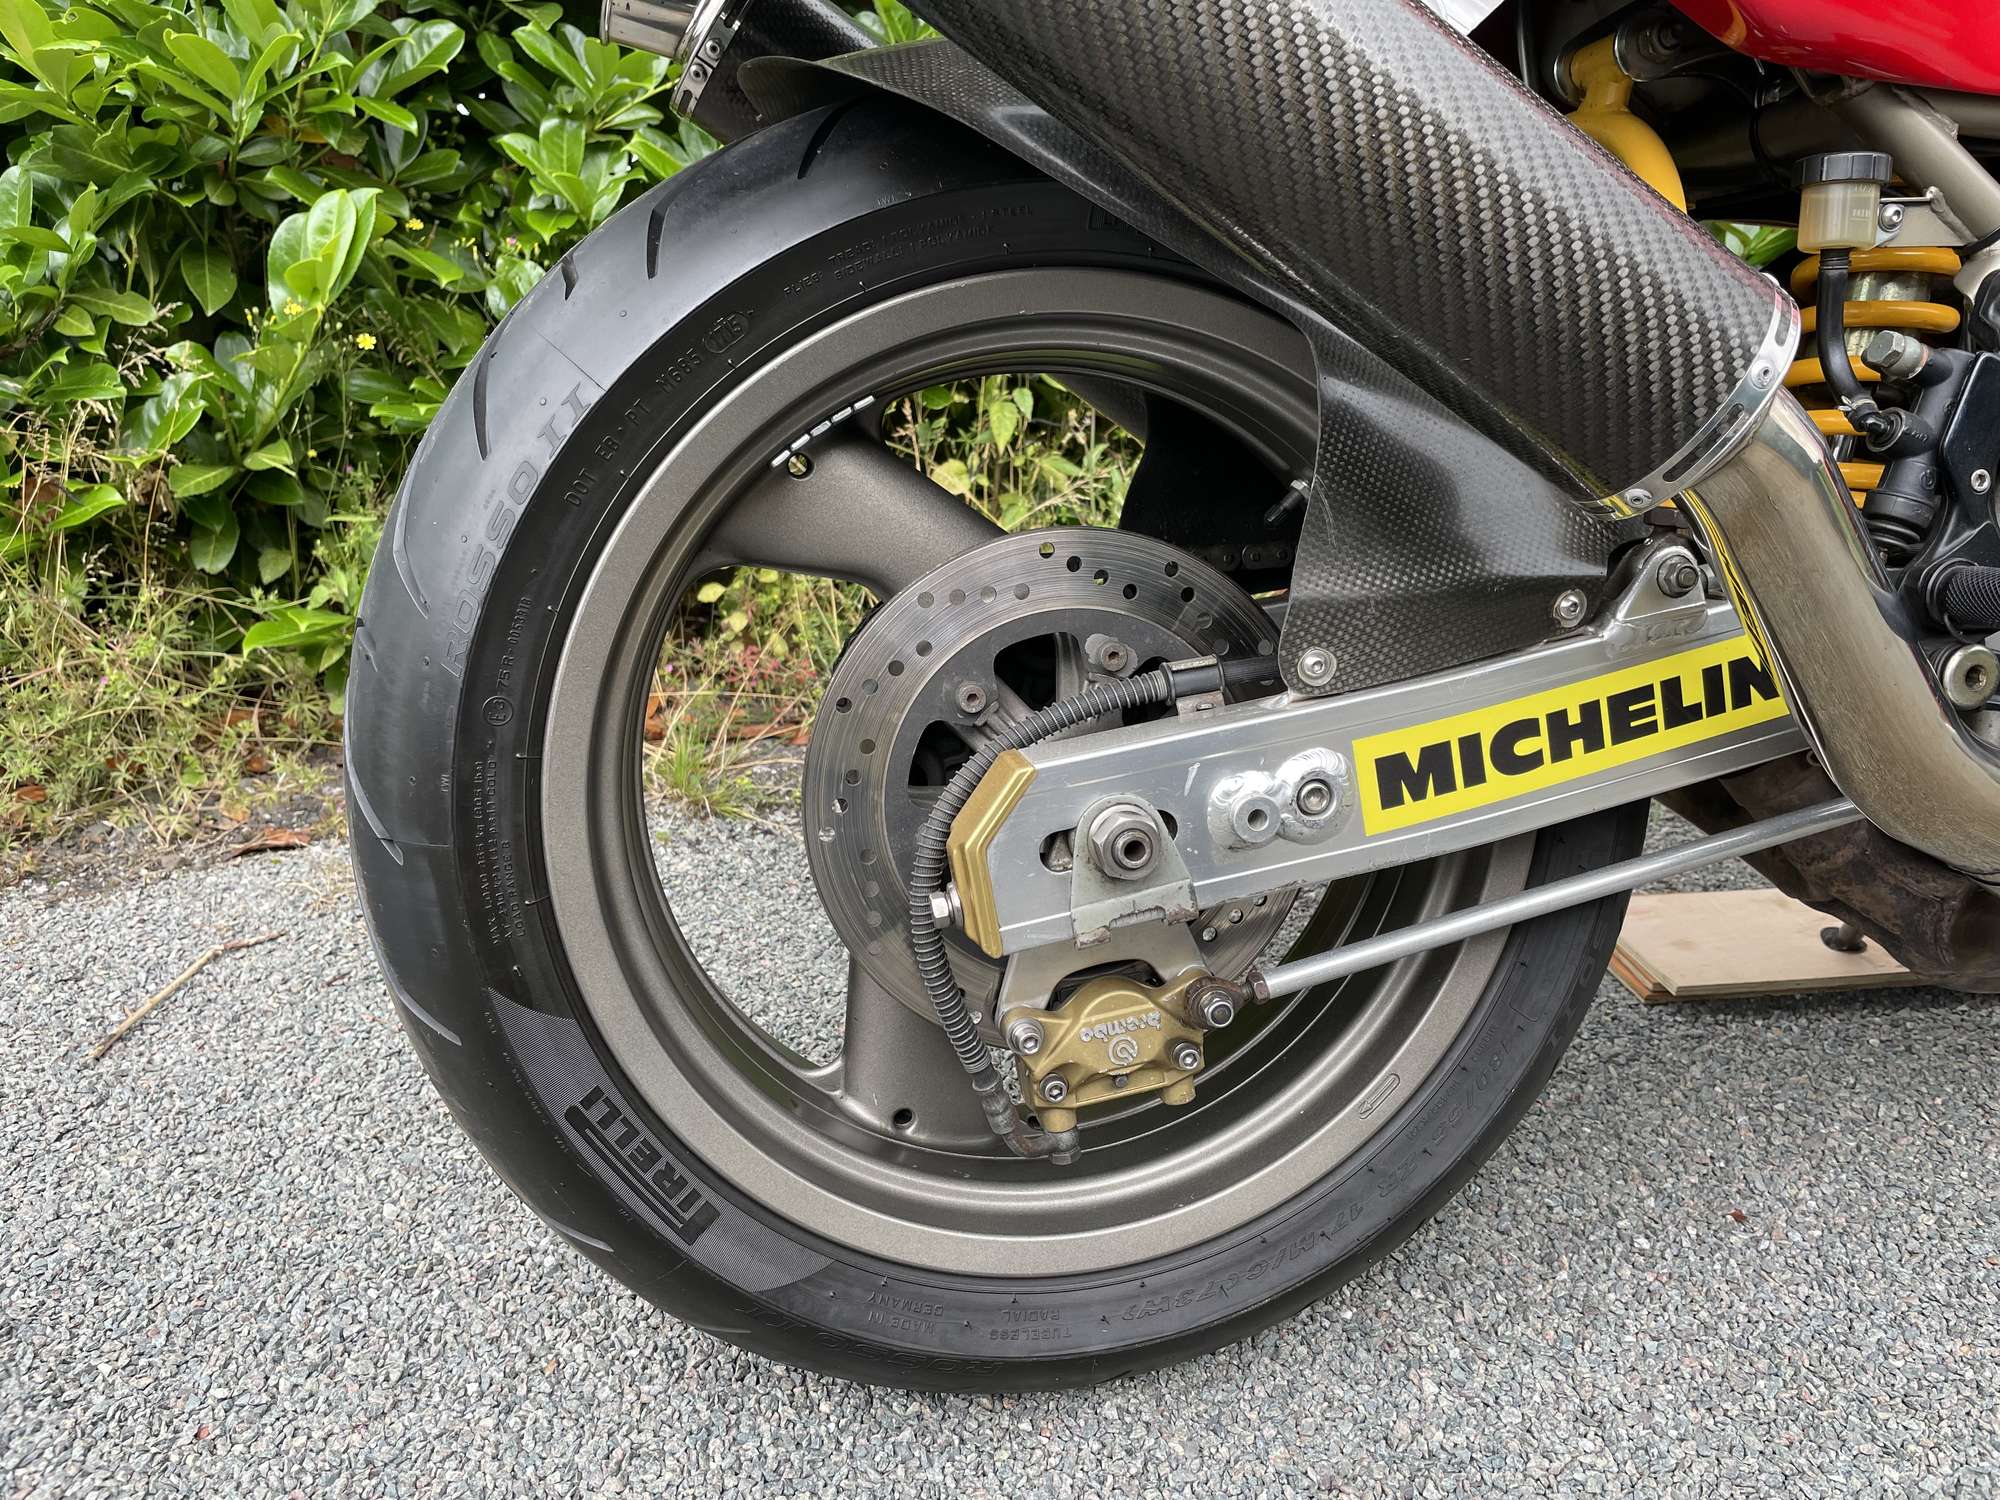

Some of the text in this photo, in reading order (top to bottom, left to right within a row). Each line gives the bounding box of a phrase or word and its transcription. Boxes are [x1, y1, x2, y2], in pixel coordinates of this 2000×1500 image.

[563, 466, 598, 509] DOT
[440, 456, 543, 677] ROSSO
[1374, 655, 1780, 810] MICHELIN
[509, 902, 527, 937] LOAD
[564, 1085, 720, 1245] PIRELLI
